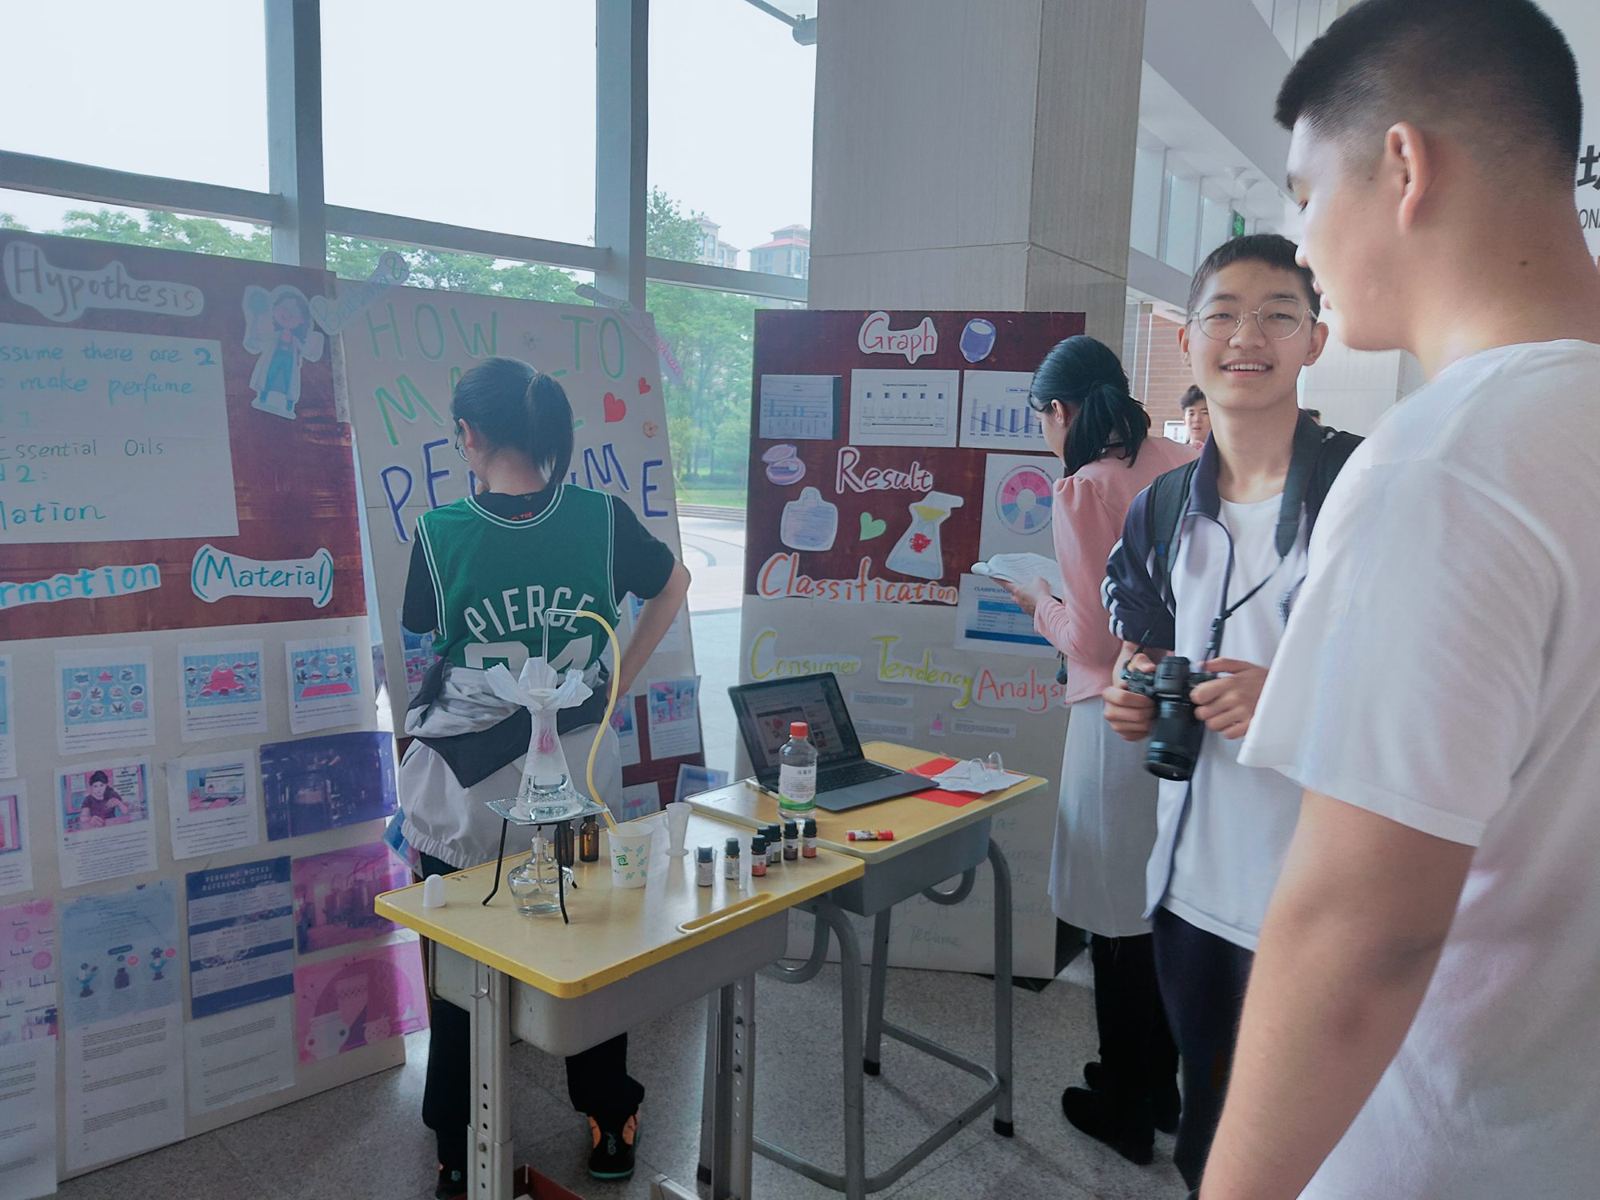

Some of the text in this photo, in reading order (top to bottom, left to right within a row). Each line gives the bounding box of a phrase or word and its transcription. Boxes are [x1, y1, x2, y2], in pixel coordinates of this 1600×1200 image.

[14, 246, 196, 317] Hypothesis
[80, 341, 134, 362] there
[150, 349, 183, 362] are
[193, 346, 217, 366] 2
[365, 302, 499, 362] HOW
[560, 314, 625, 380] TO
[862, 314, 936, 361] Graph
[20, 368, 194, 408] make perfume
[124, 437, 165, 458] Oils
[837, 447, 933, 493] Result
[380, 438, 669, 543] PEME
[759, 554, 957, 602] Classification
[463, 584, 596, 644] PIERCE
[750, 629, 1067, 712] Consumer Tendency Analysi
